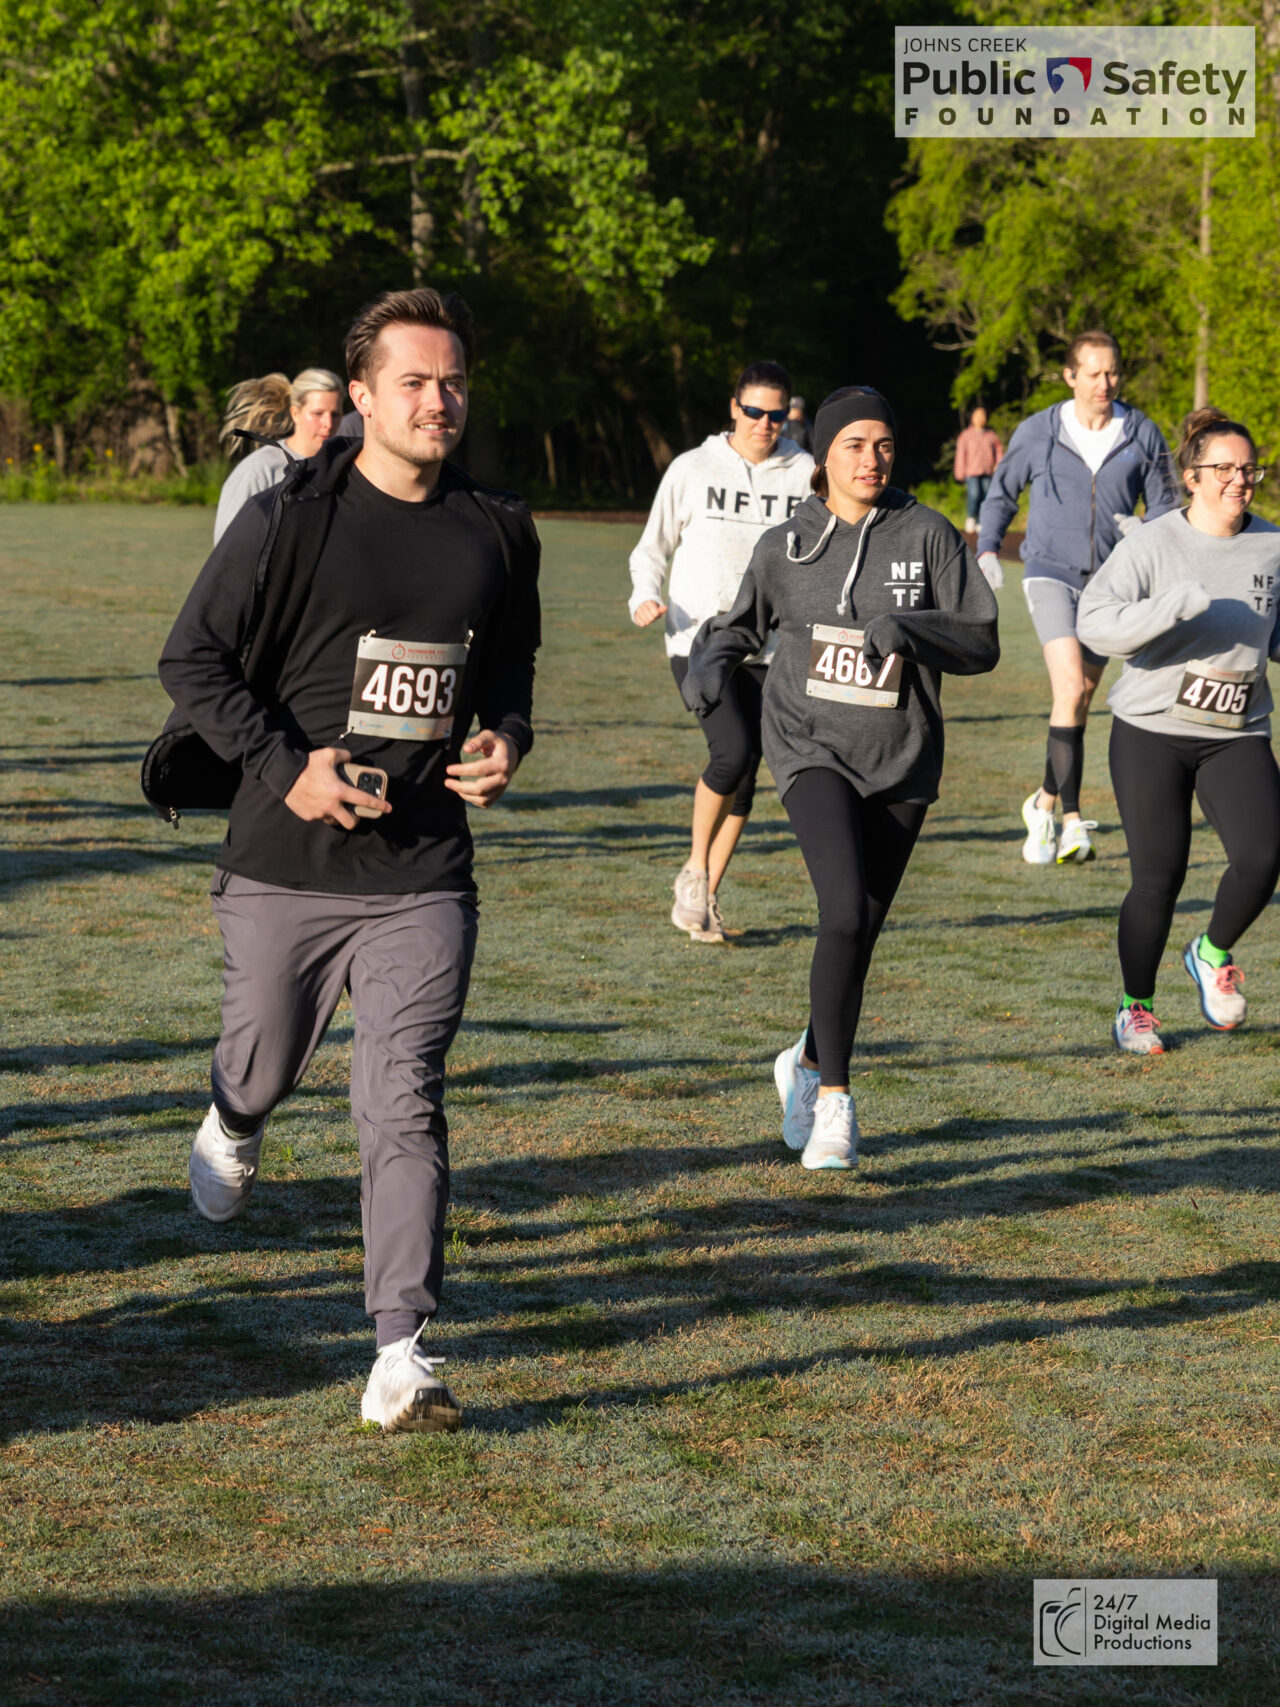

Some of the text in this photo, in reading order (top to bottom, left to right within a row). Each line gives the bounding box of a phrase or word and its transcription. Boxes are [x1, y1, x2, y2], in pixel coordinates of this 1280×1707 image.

[891, 562, 923, 580] NF
[1253, 574, 1274, 590] NF
[892, 589, 920, 607] TF
[1254, 596, 1273, 612] TF
[361, 663, 456, 716] 4693
[1182, 677, 1249, 714] 4705
